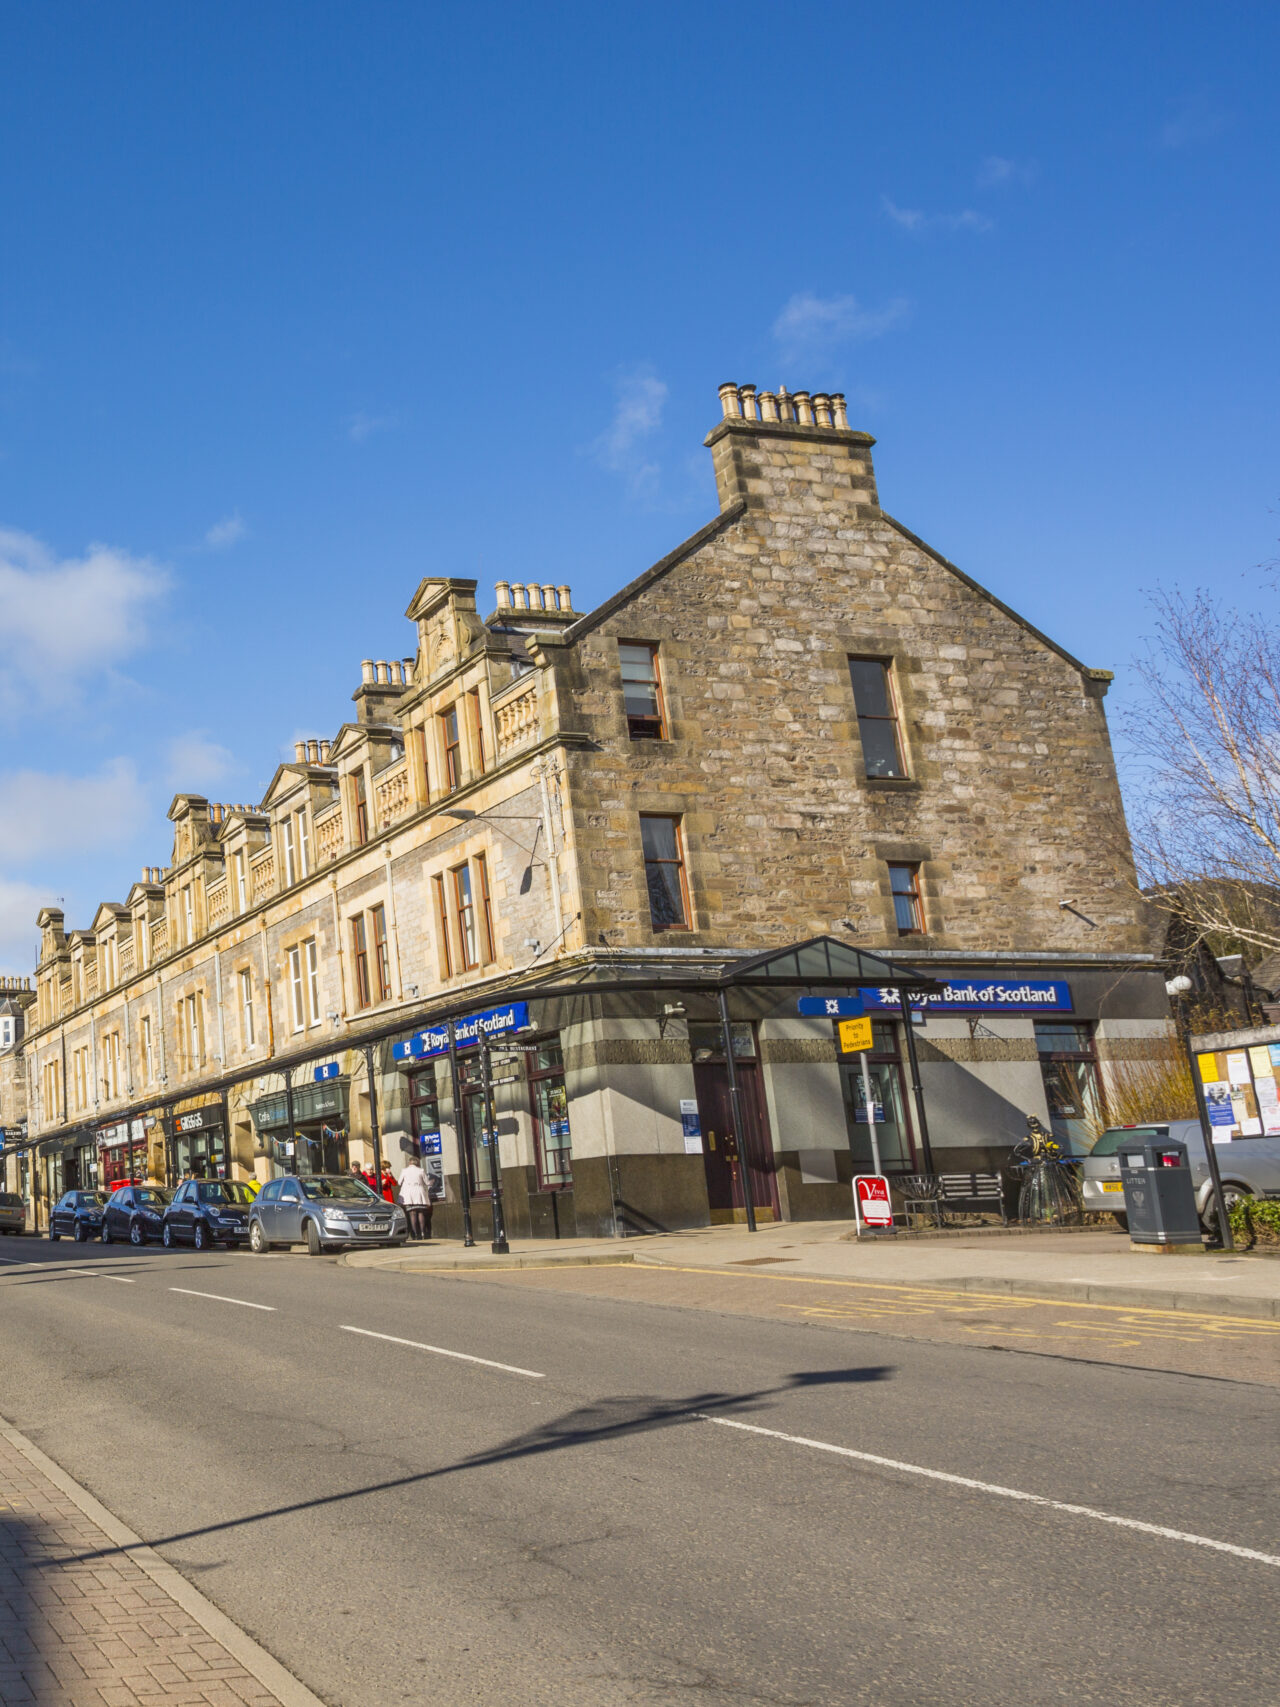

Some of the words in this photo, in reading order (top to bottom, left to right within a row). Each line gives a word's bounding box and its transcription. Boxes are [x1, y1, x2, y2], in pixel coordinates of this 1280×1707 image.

[944, 986, 979, 1002] Bank
[978, 986, 995, 1002] of
[996, 986, 1057, 1003] Scotland
[430, 1029, 450, 1050] Roya
[455, 1023, 470, 1041] ank
[470, 1019, 478, 1036] of
[478, 1009, 515, 1034] Scotland
[845, 1022, 864, 1032] Priority
[843, 1039, 871, 1049] Pedestrians
[180, 1112, 203, 1131] GREGGS
[1126, 1177, 1146, 1185] LITTER
[857, 1180, 885, 1200] Viva
